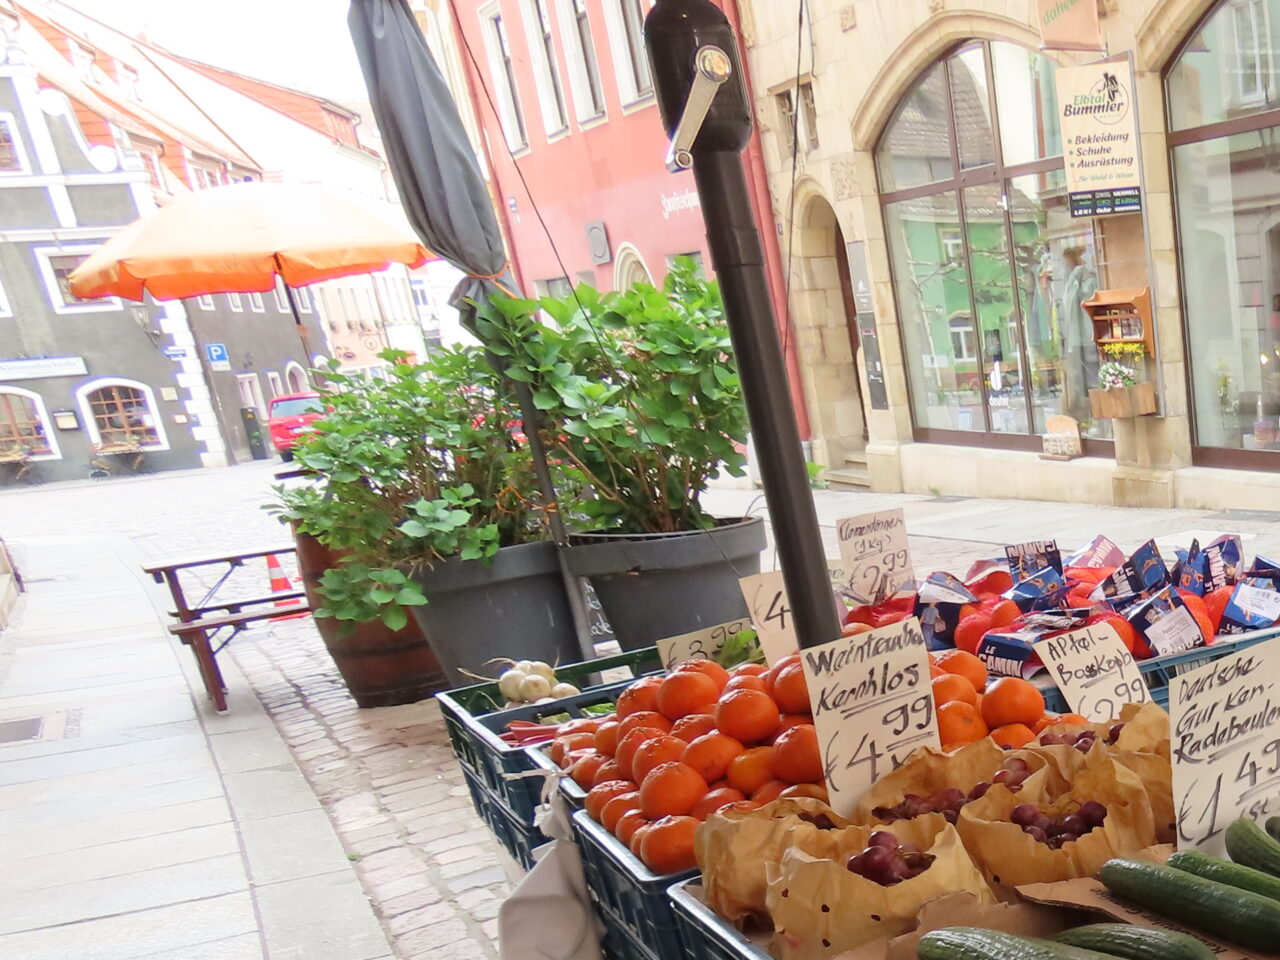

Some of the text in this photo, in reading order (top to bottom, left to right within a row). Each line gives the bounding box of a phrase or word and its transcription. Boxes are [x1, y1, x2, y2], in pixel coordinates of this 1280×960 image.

[1073, 93, 1106, 105] Elbtal
[1063, 101, 1124, 117] Bummler
[1075, 132, 1129, 145] Bekleidung
[1076, 145, 1112, 157] Schuhe
[1077, 156, 1134, 168] Ausrüstung
[212, 347, 222, 360] P
[985, 645, 997, 655] LE
[978, 654, 1024, 679] GAMIN
